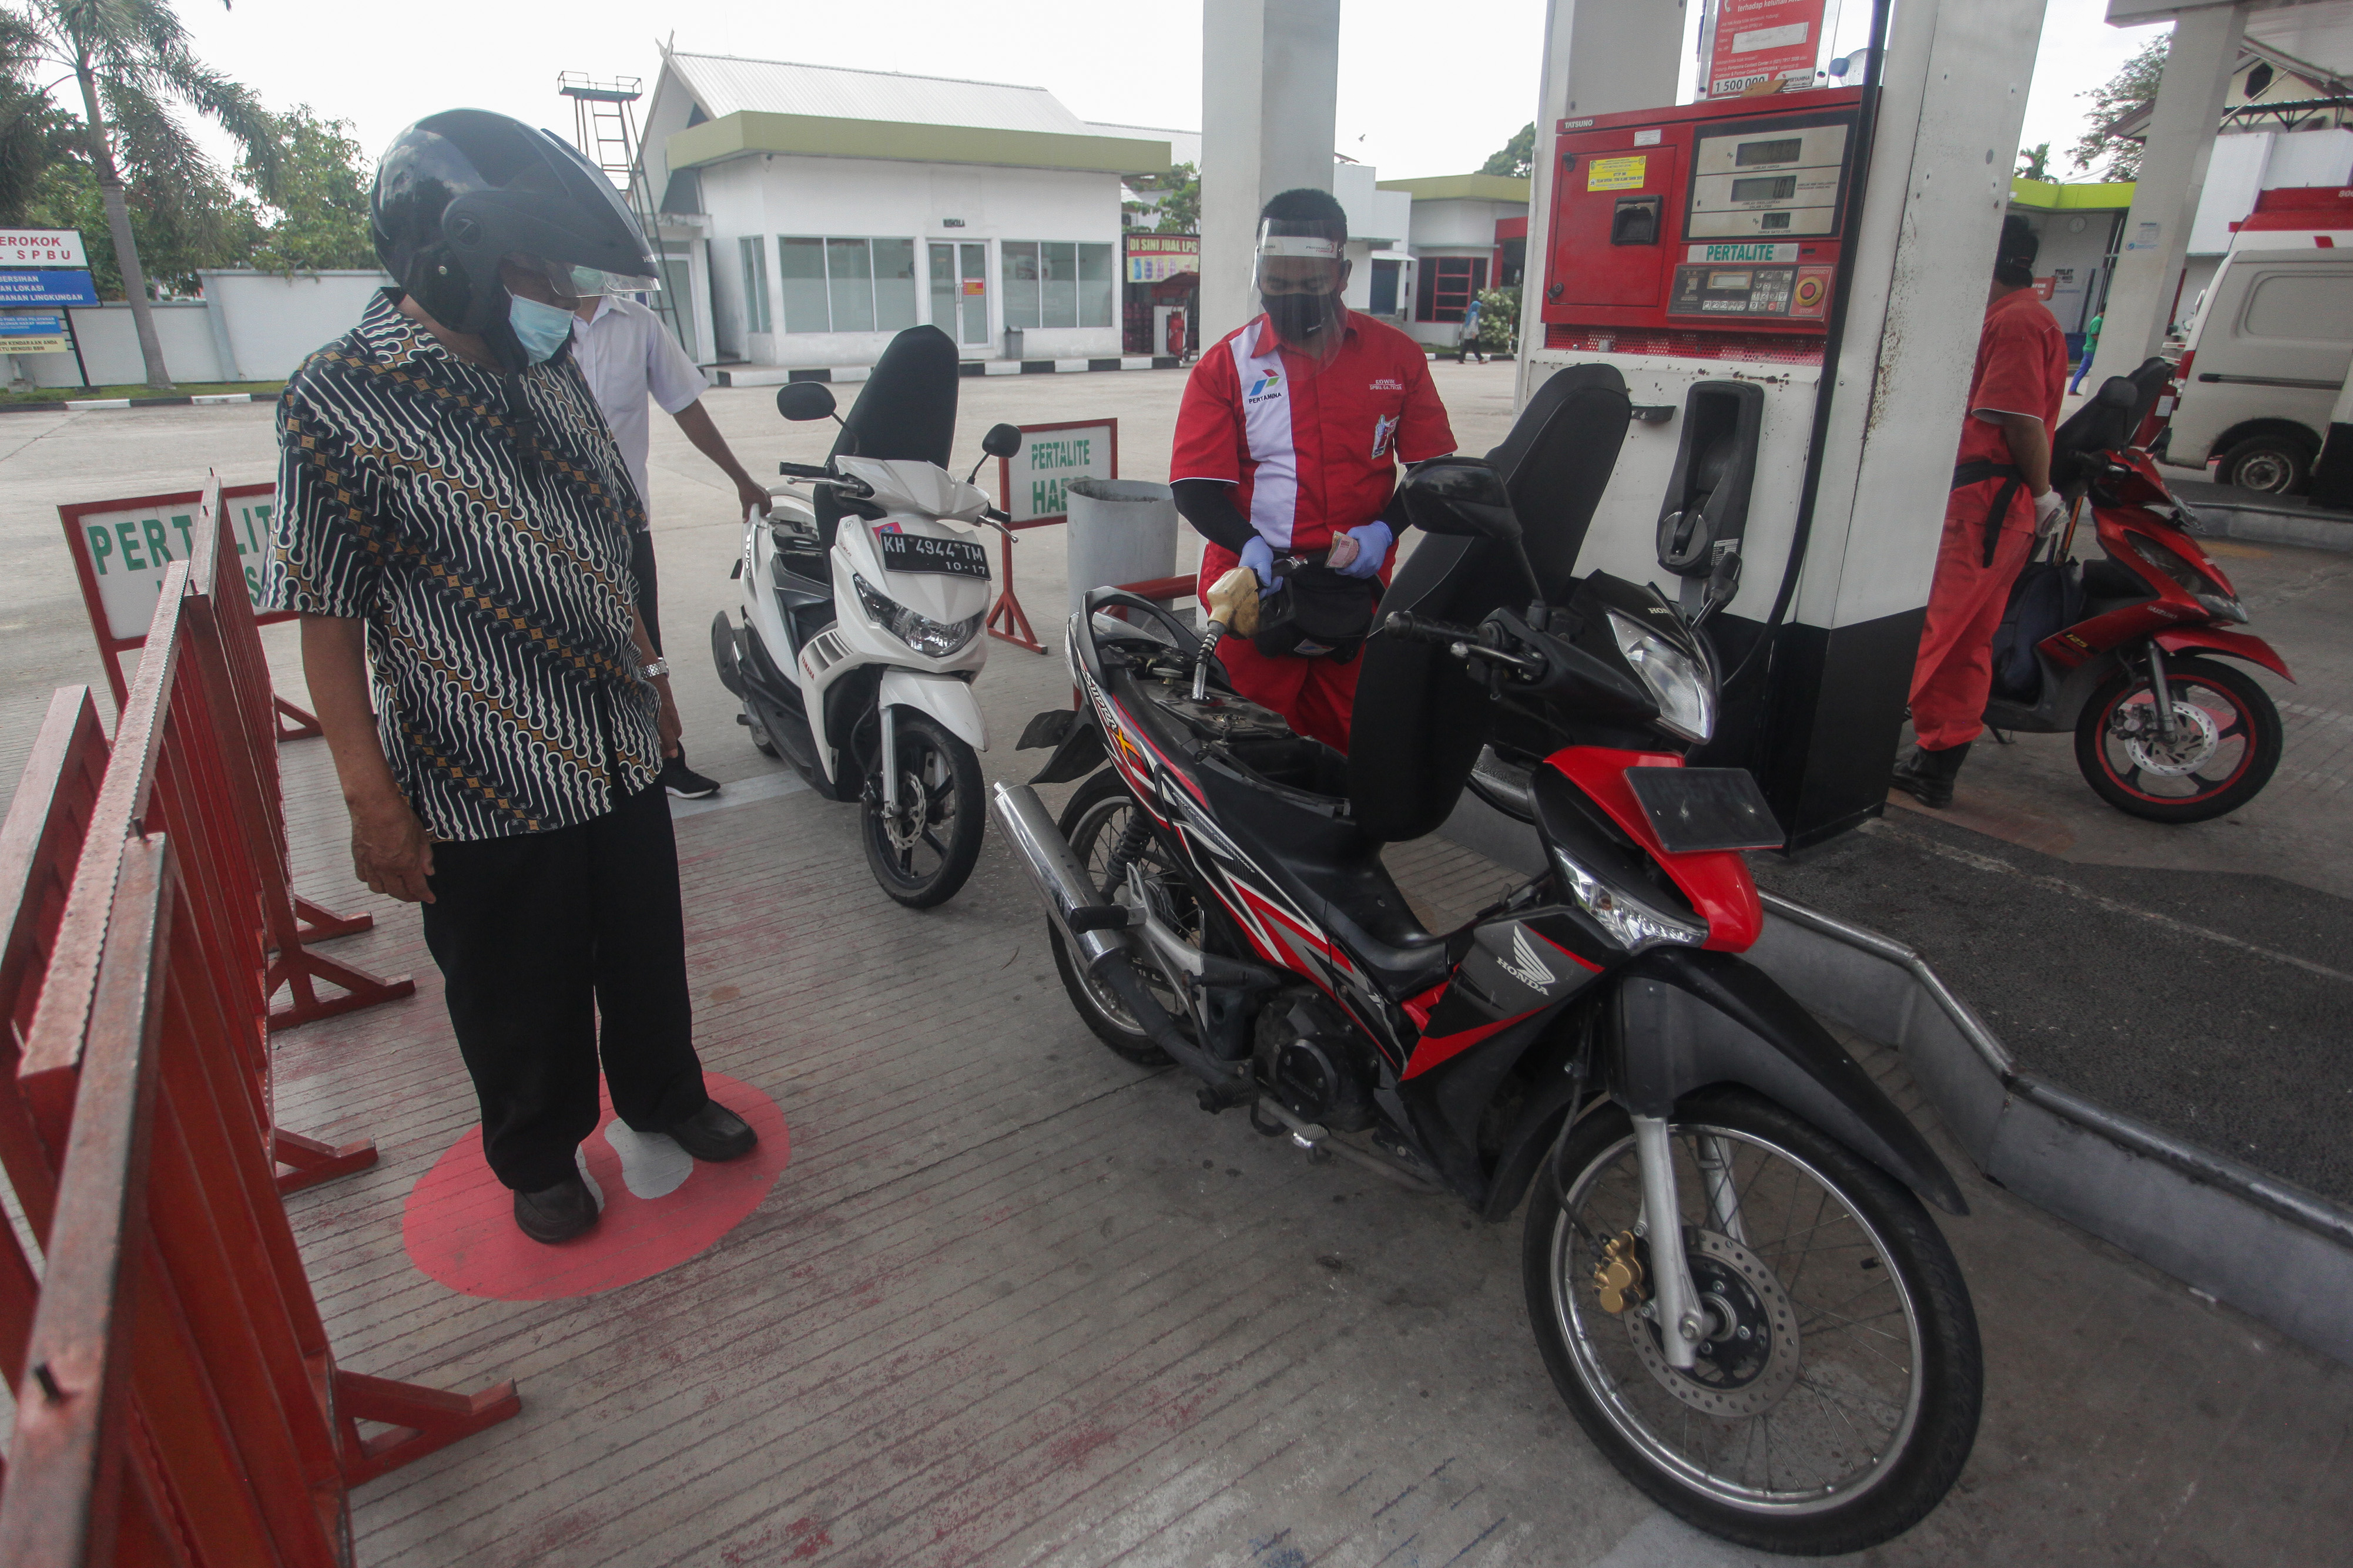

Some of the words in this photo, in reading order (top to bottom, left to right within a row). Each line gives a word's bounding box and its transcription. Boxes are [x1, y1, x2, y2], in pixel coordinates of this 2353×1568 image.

[1738, 2, 1762, 12] terhadap
[1716, 82, 1720, 92] 1
[1724, 80, 1742, 91] 500
[1564, 119, 1593, 129] TATSUNO
[0, 237, 62, 247] EROKOK
[1129, 238, 1139, 251] DI
[1141, 239, 1160, 251] SINI
[1161, 239, 1181, 252] JUAL
[1182, 240, 1197, 253] LPG
[1706, 244, 1774, 261] PERTALITE
[1248, 392, 1282, 404] PERTAMINA
[1031, 439, 1090, 470] PERTALITE
[883, 536, 906, 553] KH
[916, 539, 955, 558] 4944
[962, 544, 983, 562] TM
[2147, 605, 2177, 619] SUZUKI
[2066, 634, 2089, 648] 125
[802, 654, 814, 681] YAMAHA
[1085, 671, 1118, 730] SUPRA
[1108, 726, 1142, 762] X
[1214, 834, 1256, 874] PERFORMANCE
[1496, 956, 1550, 996] HONDA
